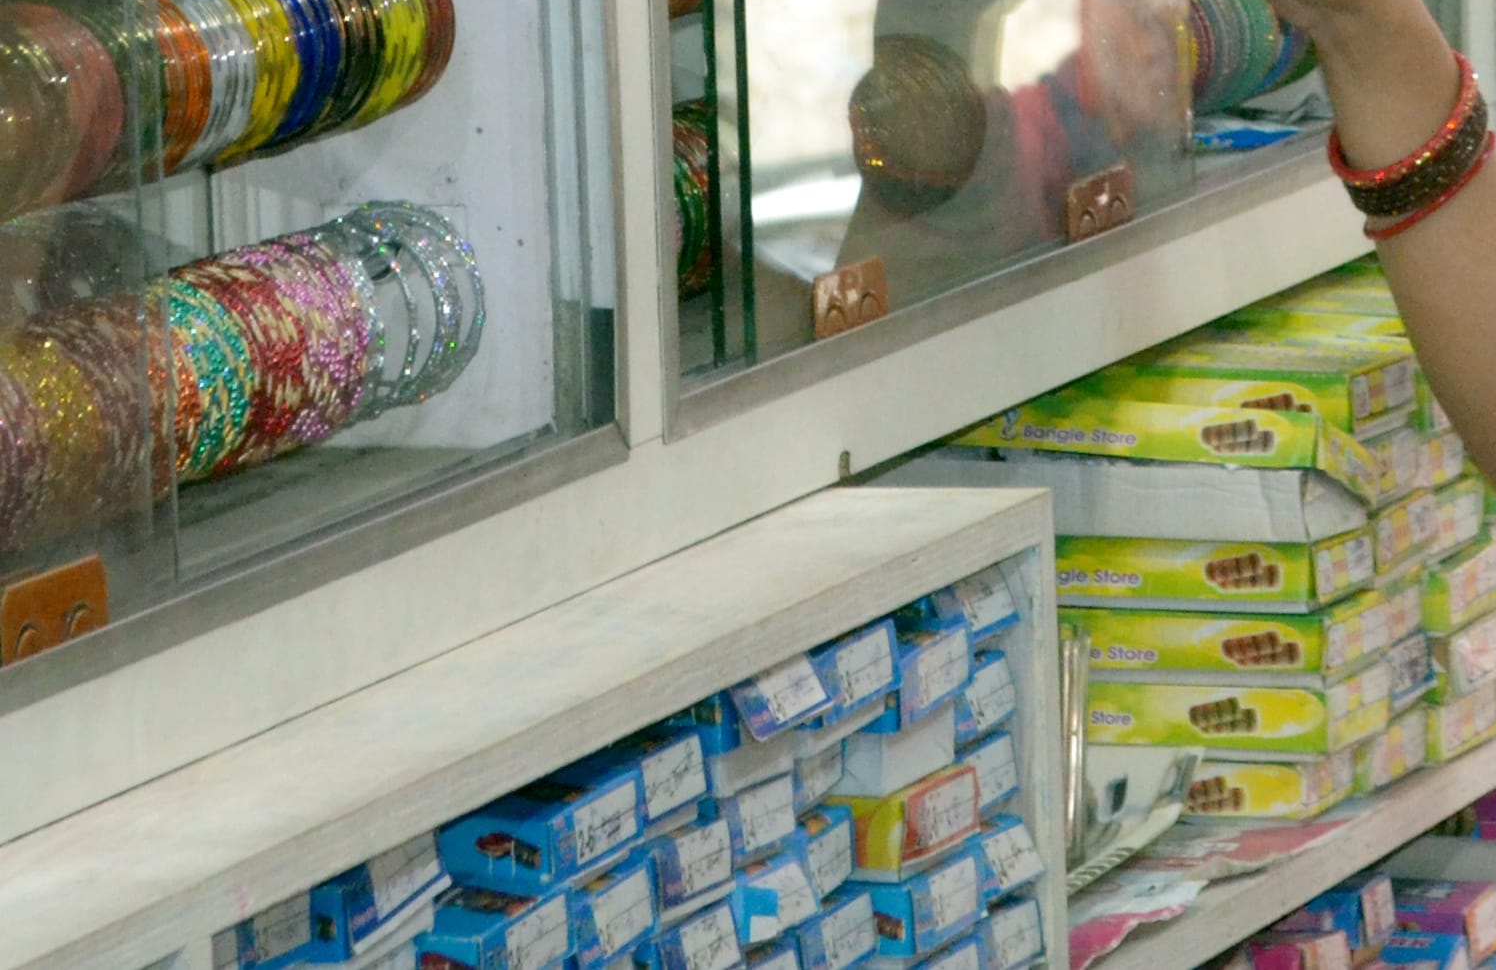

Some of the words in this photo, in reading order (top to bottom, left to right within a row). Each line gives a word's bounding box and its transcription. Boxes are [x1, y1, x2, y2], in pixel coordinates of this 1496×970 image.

[1023, 424, 1085, 443] Bangle
[1091, 429, 1137, 445] Store
[1056, 568, 1089, 586] gle
[1094, 569, 1139, 584] Store
[1107, 645, 1156, 661] Store
[1091, 710, 1132, 726] Store
